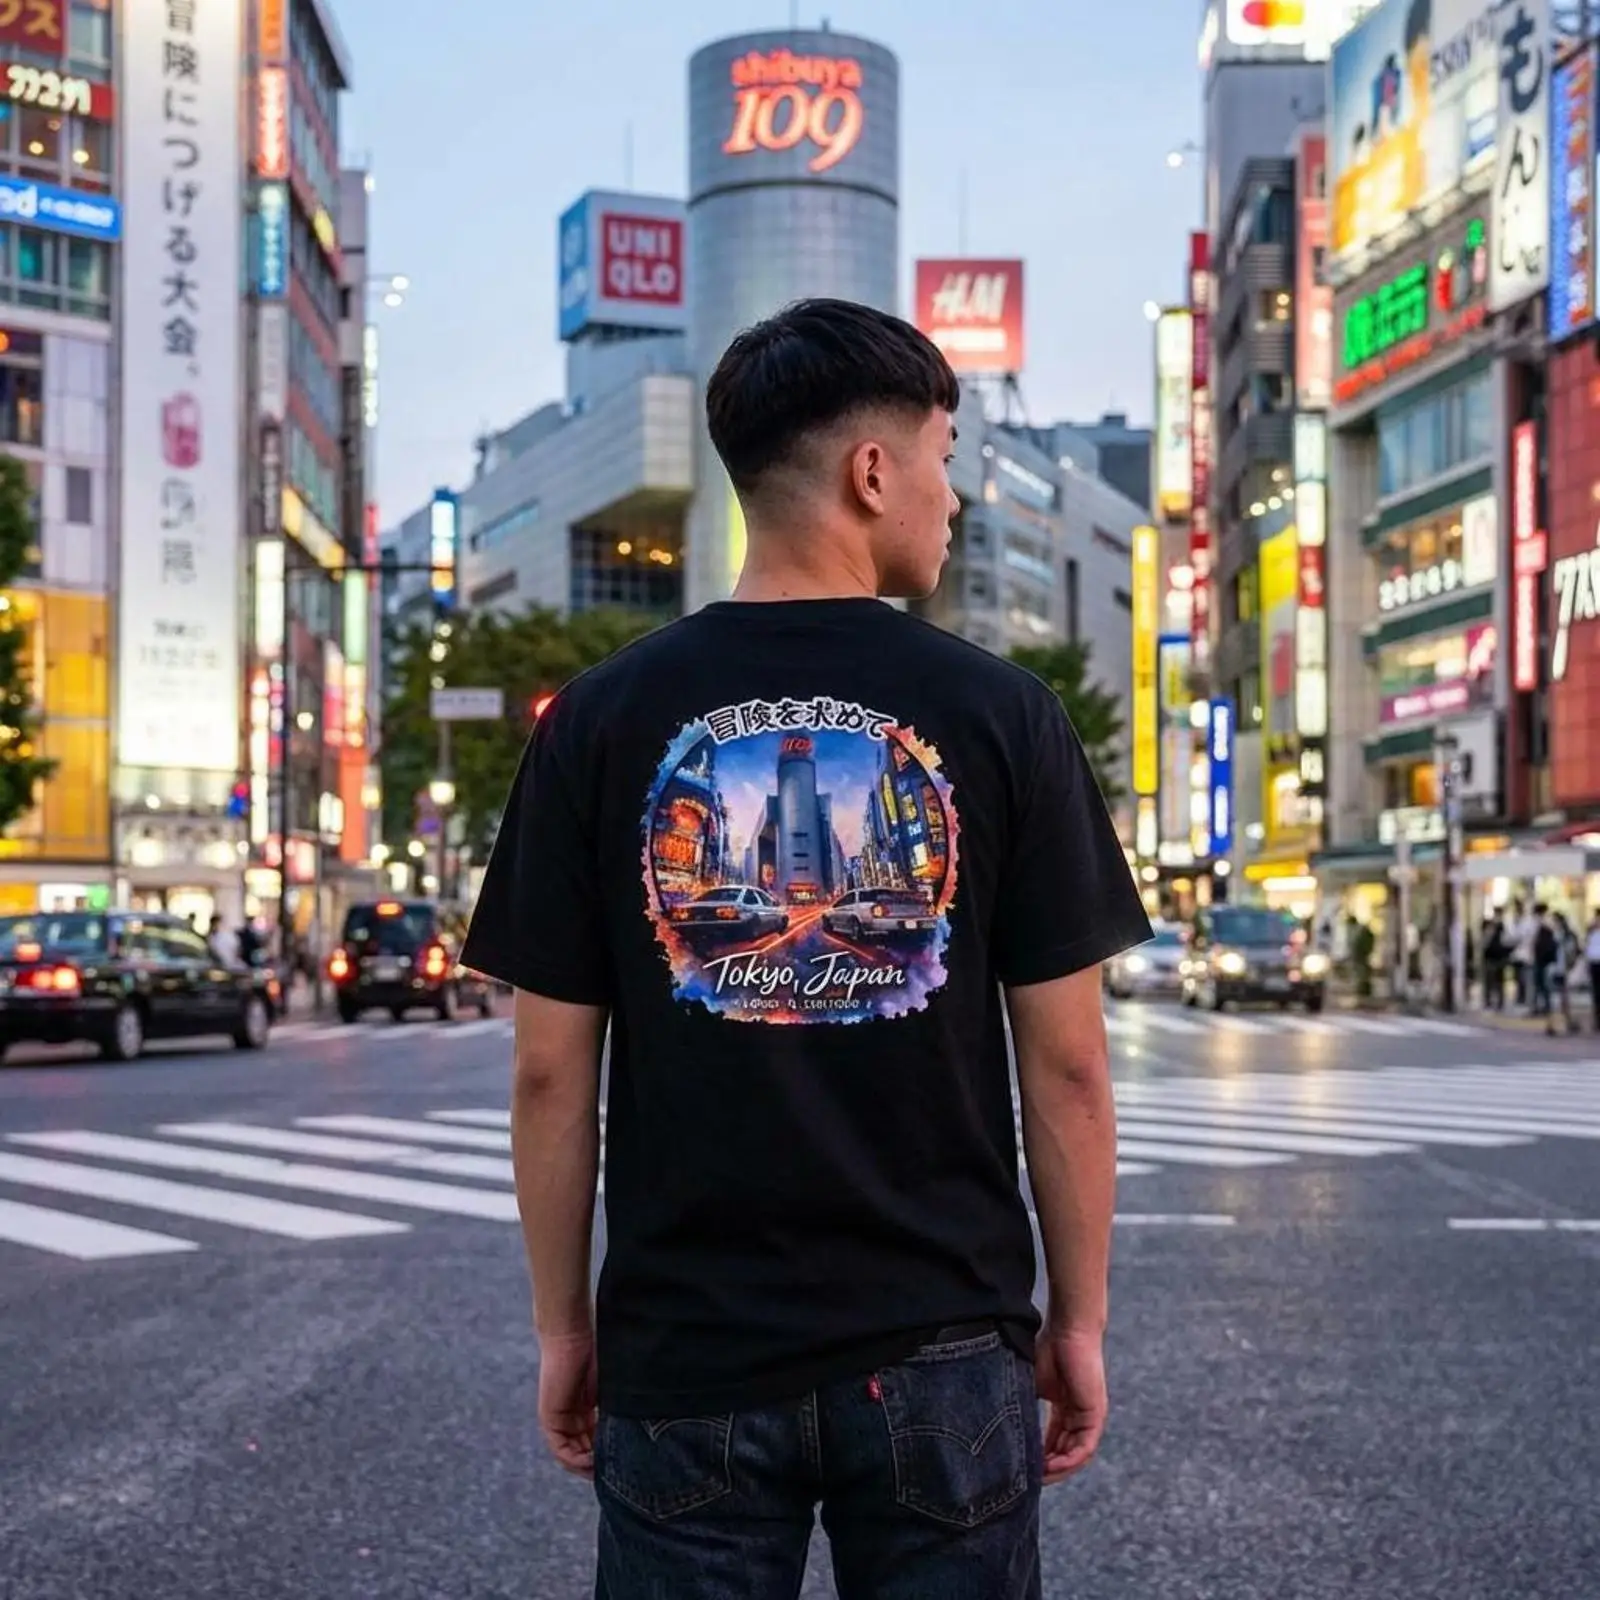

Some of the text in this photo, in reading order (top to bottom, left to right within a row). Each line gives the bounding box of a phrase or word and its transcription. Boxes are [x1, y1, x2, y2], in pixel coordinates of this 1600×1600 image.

[732, 48, 863, 91] shibuya
[722, 86, 863, 173] 109
[609, 221, 671, 259] UNI
[609, 258, 677, 297] QLO
[705, 697, 897, 745] 冒険を求めて
[702, 950, 906, 1000] Tokyo, Japan
